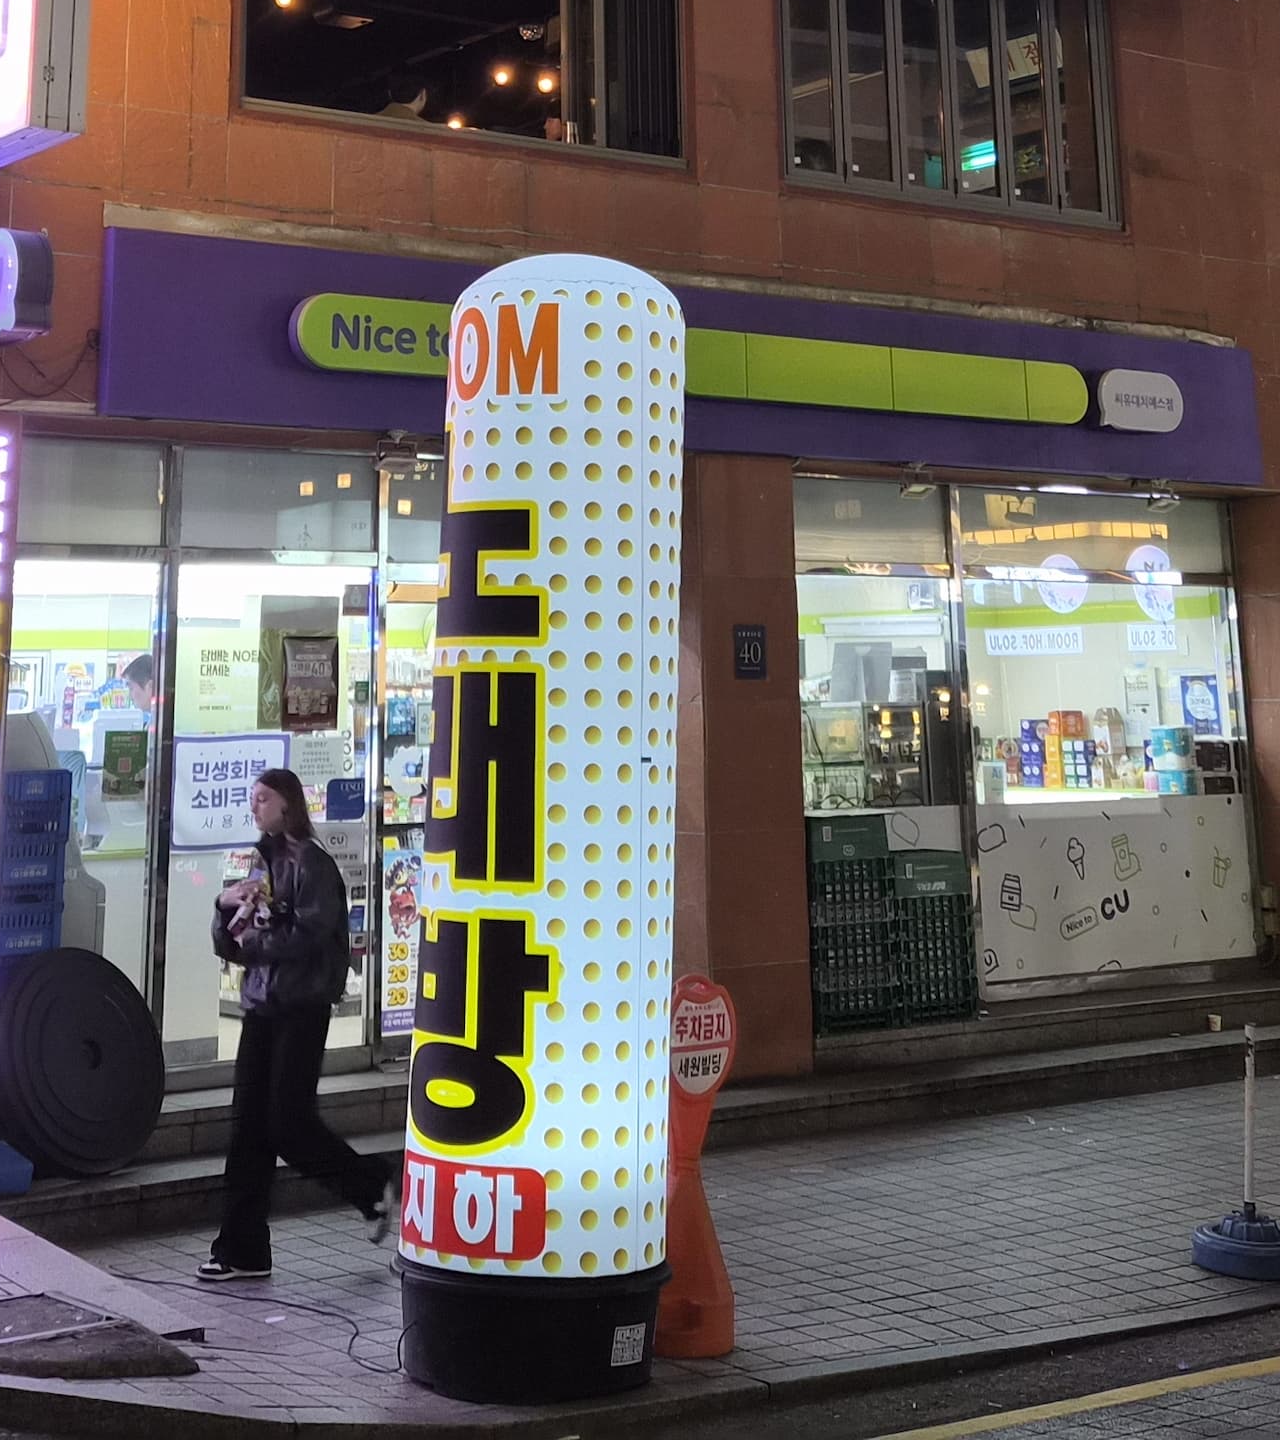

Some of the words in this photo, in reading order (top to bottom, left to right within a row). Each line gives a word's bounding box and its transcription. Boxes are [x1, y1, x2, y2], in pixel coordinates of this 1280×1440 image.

[331, 312, 417, 356] Nice
[452, 303, 559, 401] OM
[740, 642, 761, 663] 40
[192, 759, 266, 783] 민생회복
[192, 787, 252, 809] 소비쿠
[330, 835, 344, 845] CU
[1101, 888, 1129, 920] CU
[1066, 920, 1083, 933] Nice
[1084, 916, 1093, 924] to
[676, 1013, 725, 1042] 주차금지
[679, 1054, 721, 1078] 세원빌딩
[401, 1172, 521, 1256] 지하
